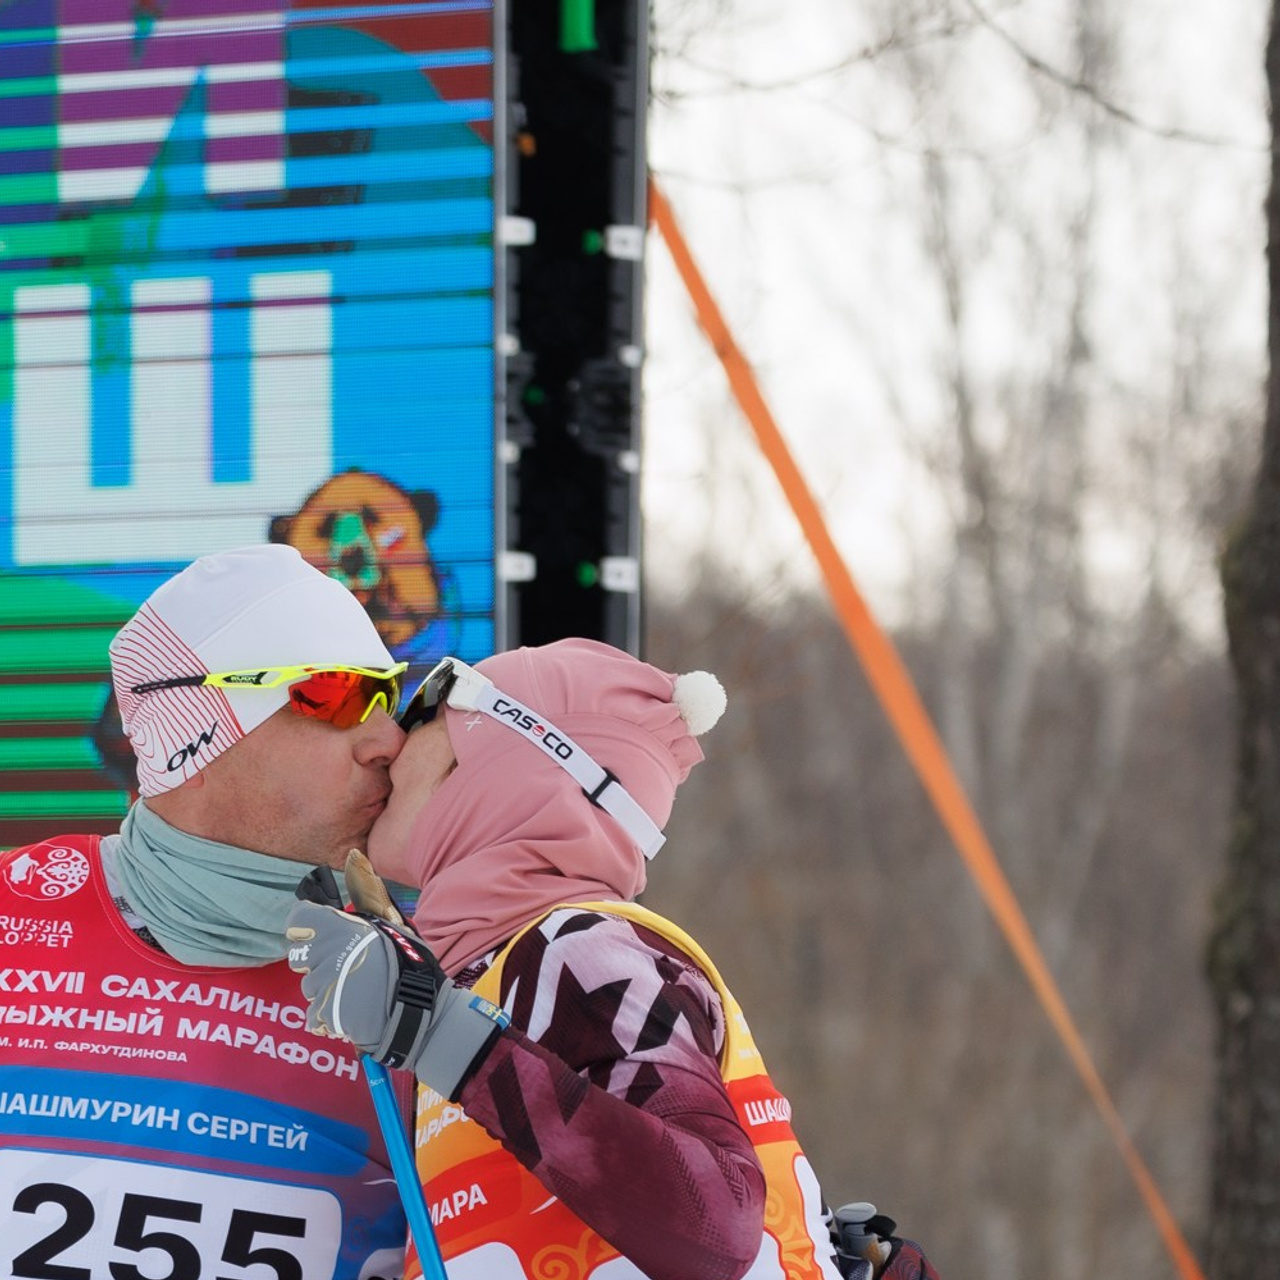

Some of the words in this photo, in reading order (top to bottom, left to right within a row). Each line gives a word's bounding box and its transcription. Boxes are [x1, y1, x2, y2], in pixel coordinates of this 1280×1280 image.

[100, 974, 350, 1043] САХАЛИНС
[17, 1037, 48, 1050] И.П.
[53, 1040, 188, 1063] ФАРХУТДИНОВА
[176, 1017, 360, 1082] МАРАФОН
[186, 1111, 309, 1152] СЕРГЕЙ
[428, 1183, 488, 1227] МАРА
